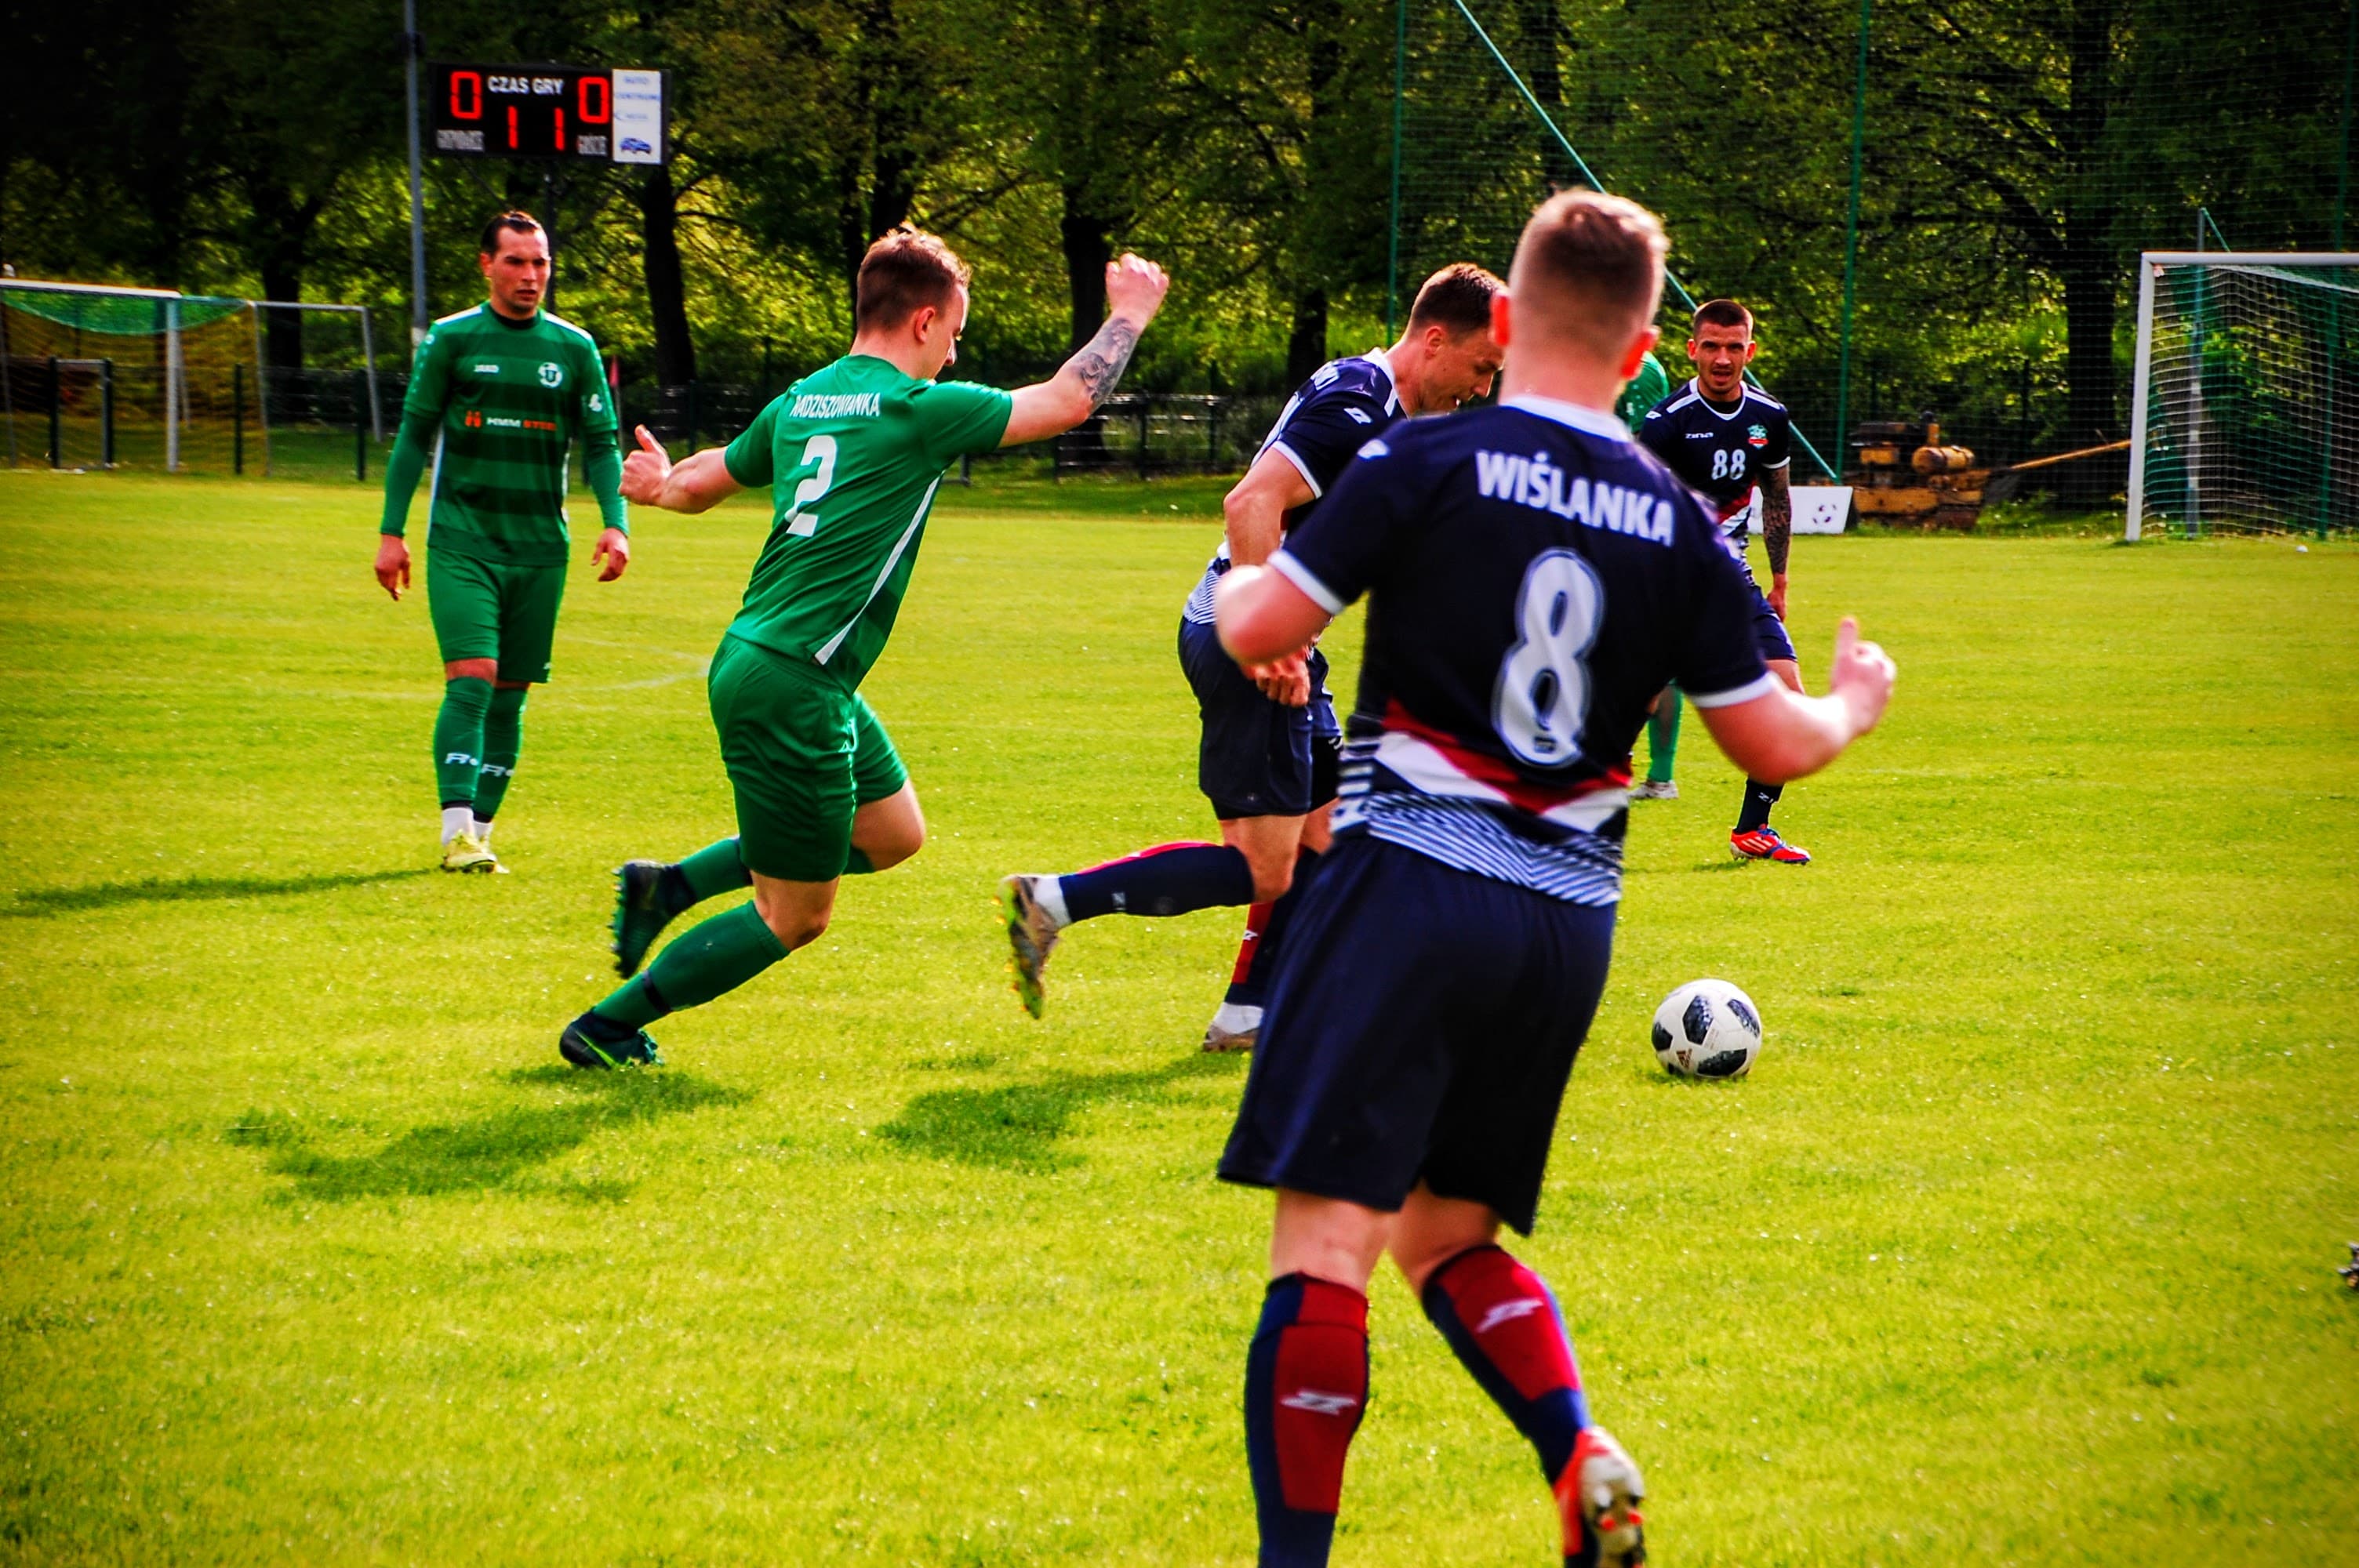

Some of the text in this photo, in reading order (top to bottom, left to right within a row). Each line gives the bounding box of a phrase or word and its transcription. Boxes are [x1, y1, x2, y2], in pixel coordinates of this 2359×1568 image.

[450, 71, 482, 119] 0
[488, 76, 564, 95] CZAS GRY
[578, 77, 609, 124] 0
[784, 434, 838, 537] 2
[1711, 448, 1746, 480] 88
[1475, 450, 1675, 547] WIŚLANKA
[1492, 547, 1605, 768] 8
